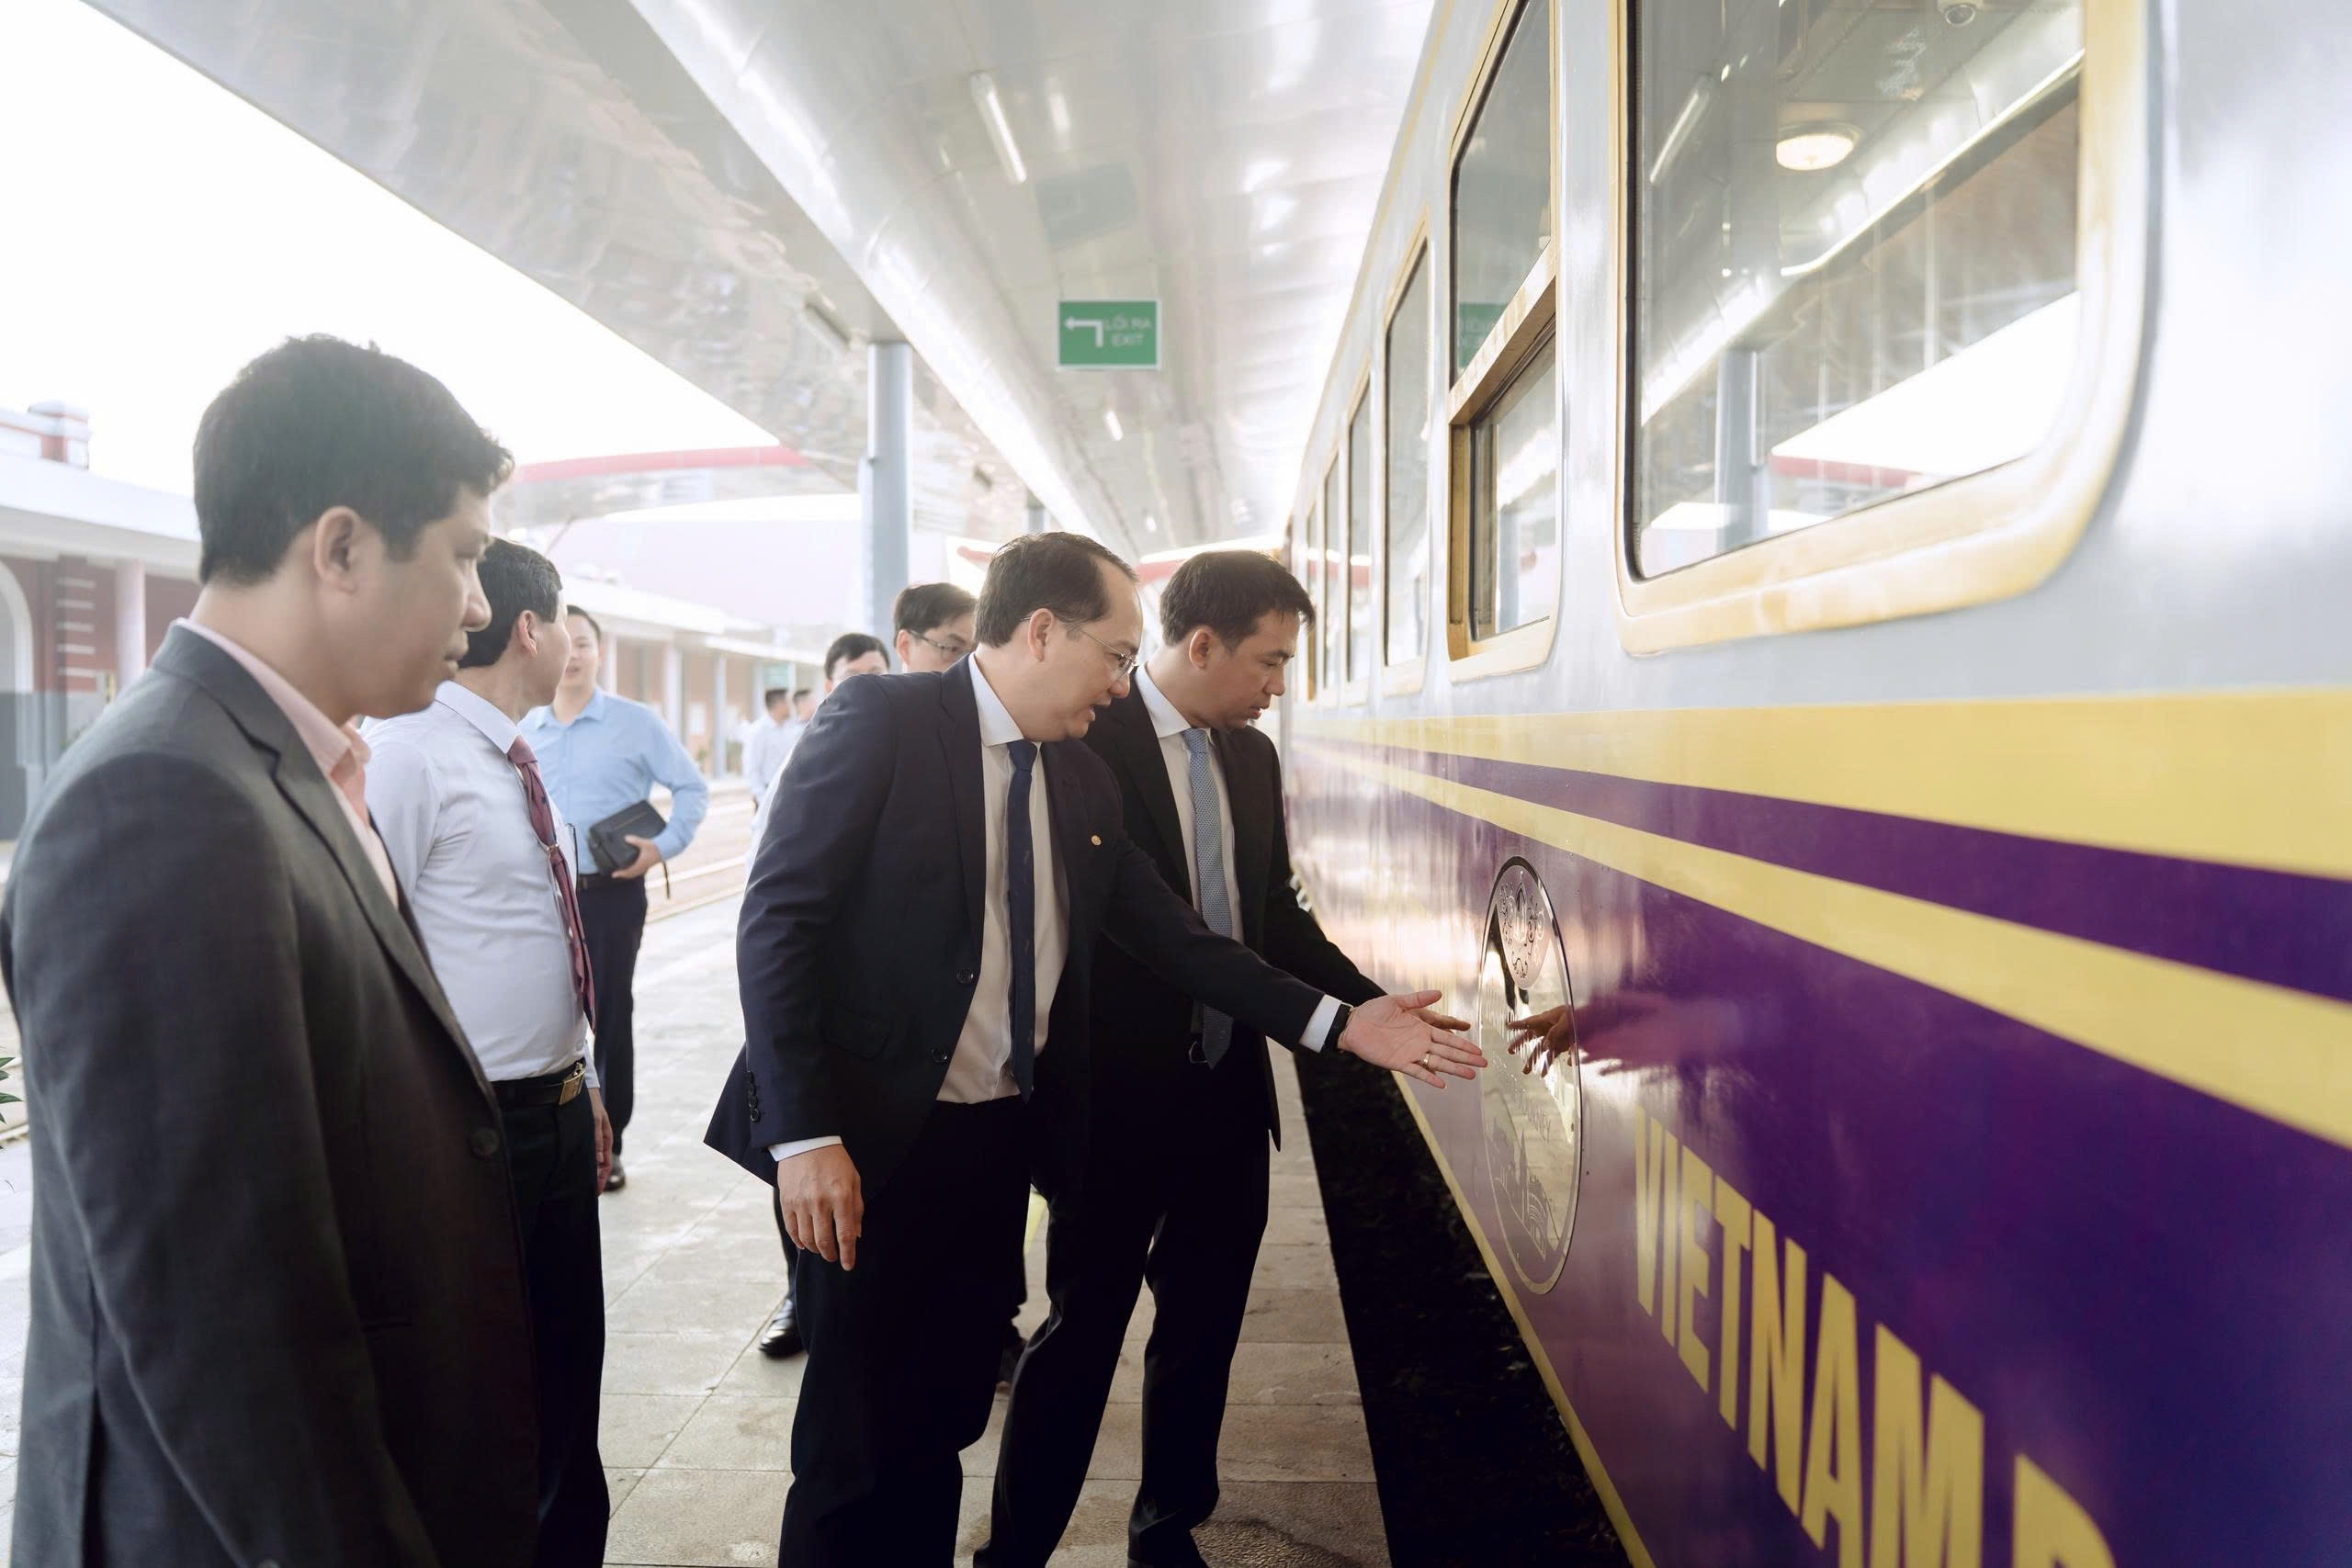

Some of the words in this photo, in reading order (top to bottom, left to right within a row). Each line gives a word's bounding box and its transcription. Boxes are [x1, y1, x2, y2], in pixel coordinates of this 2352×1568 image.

[1131, 316, 1154, 331] RA
[1110, 332, 1145, 346] EXIT
[1634, 1102, 1984, 1568] VIETNAM
